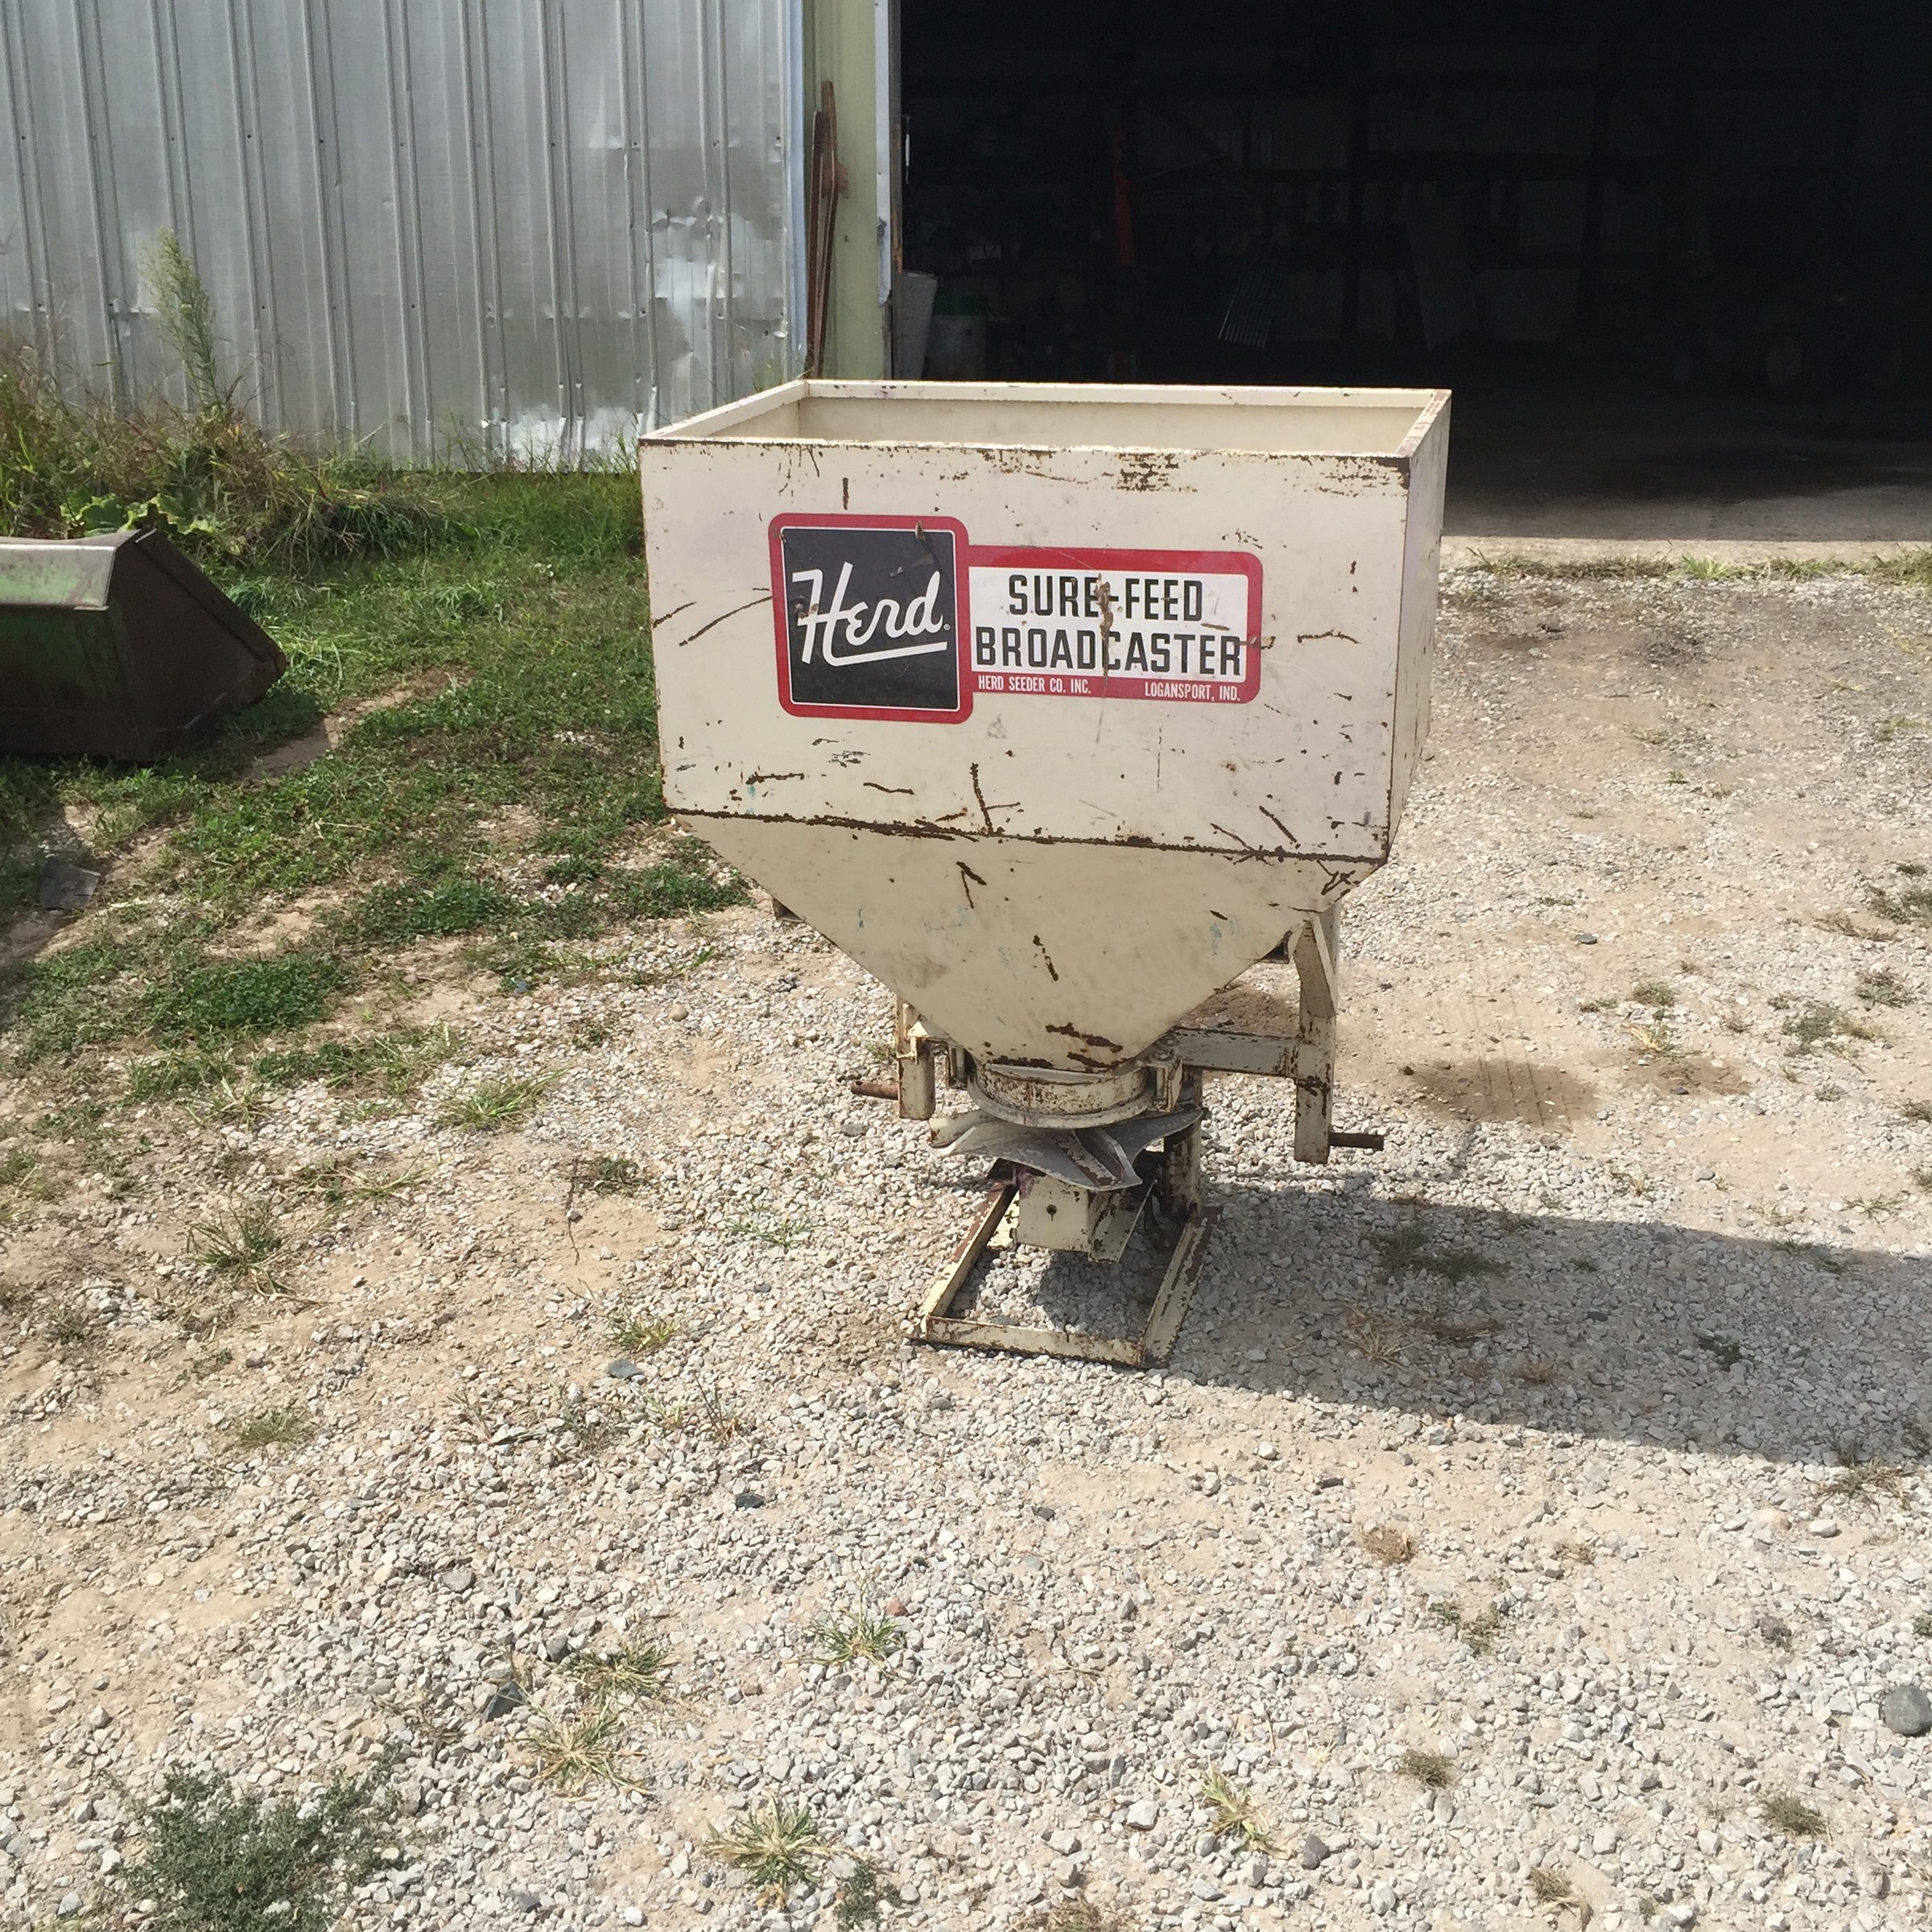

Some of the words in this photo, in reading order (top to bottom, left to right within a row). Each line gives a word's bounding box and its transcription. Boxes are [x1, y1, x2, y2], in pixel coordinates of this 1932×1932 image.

[792, 561, 947, 667] Herd
[1009, 574, 1202, 621] SURE-FEED
[976, 625, 1241, 675] BROADCASTER
[978, 675, 1004, 691] HERD
[1009, 676, 1045, 692] SEEDER
[1050, 679, 1066, 693] CO.
[1071, 679, 1092, 694] INC.
[1145, 681, 1215, 702] LOGANSPORT,
[1220, 685, 1241, 701] IND.
